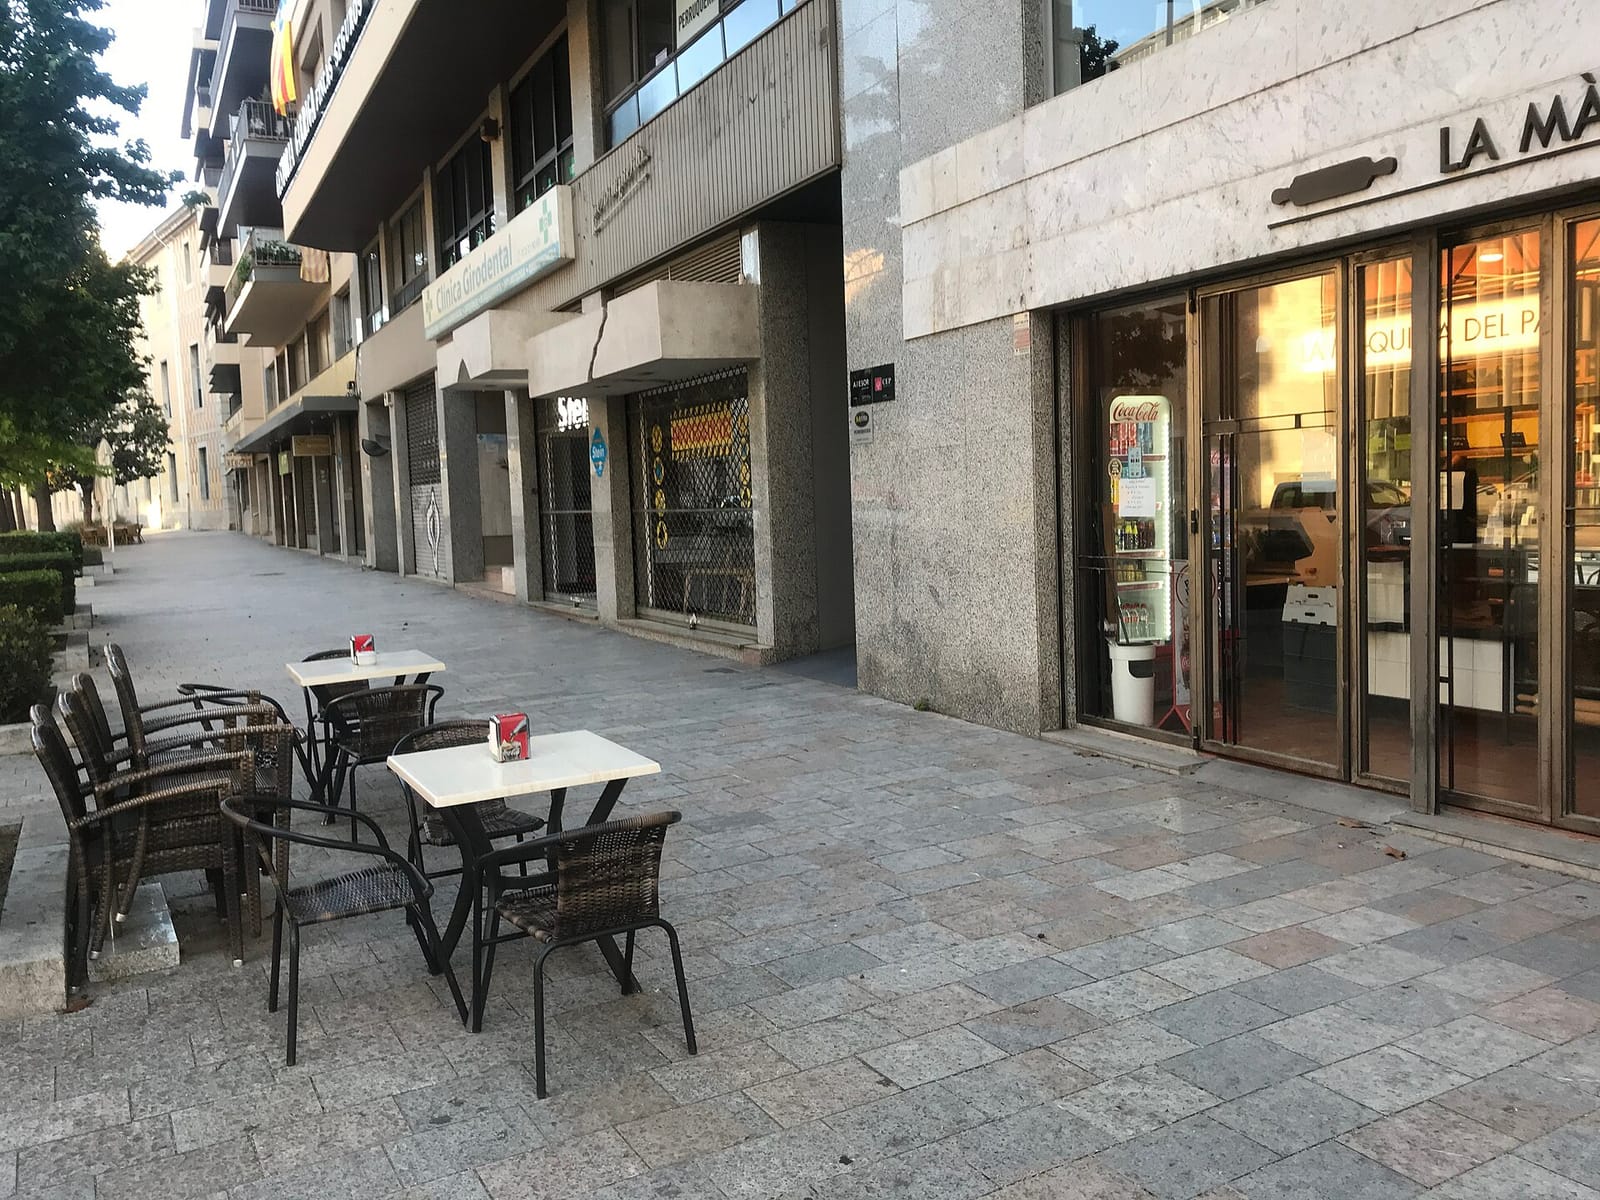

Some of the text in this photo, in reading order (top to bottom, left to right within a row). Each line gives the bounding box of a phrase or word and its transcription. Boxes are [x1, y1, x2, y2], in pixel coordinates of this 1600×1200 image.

[1440, 117, 1499, 173] LA
[463, 234, 513, 295] Girodental
[1465, 313, 1510, 341] DEL
[1113, 402, 1160, 421] Coca-Cola
